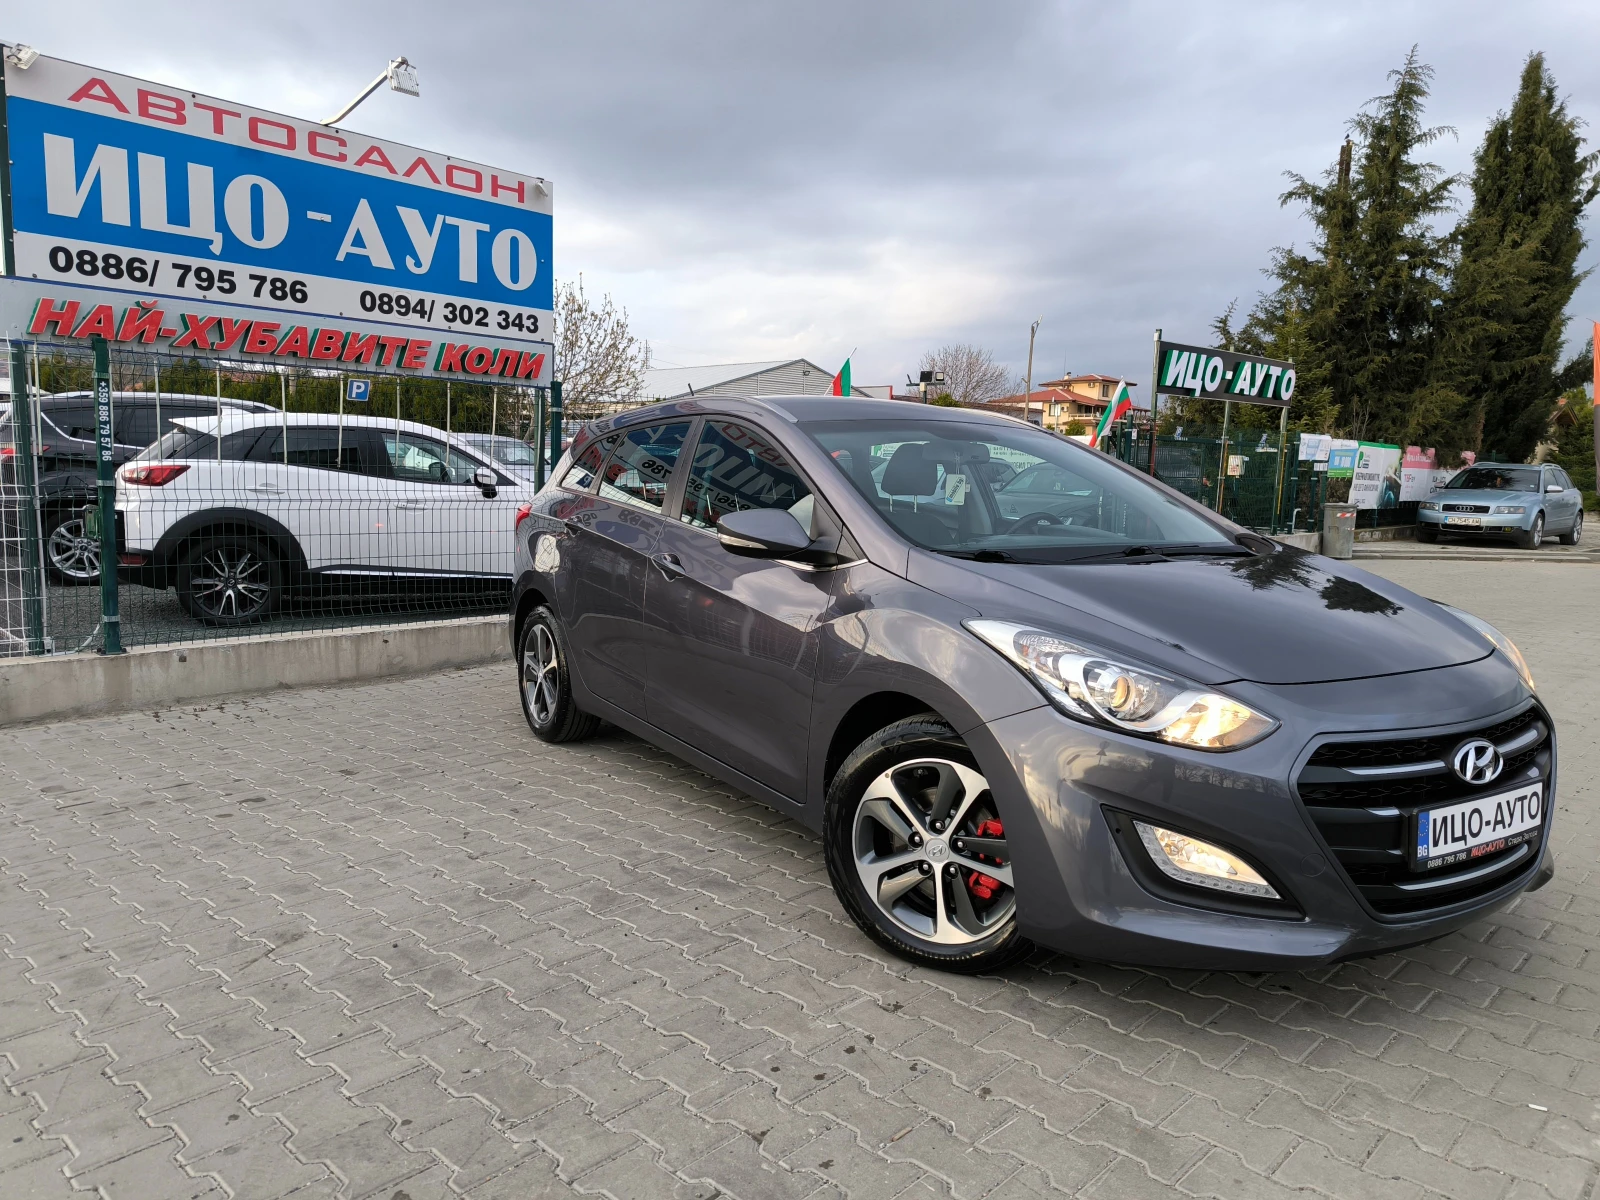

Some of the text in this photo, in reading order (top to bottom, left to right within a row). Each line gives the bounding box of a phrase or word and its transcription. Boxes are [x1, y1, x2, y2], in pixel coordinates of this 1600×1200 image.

[68, 77, 525, 204] АВТОСАЛОН
[48, 246, 309, 304] 0886/ 795 786
[28, 297, 546, 380] НАЙ-ХУБАВИТЕ КОЛИ
[359, 290, 539, 334] 0894/ 302 343
[352, 382, 365, 397] P
[1162, 350, 1296, 400] ИЦО-АУТО
[98, 381, 112, 461] +359 886 79 57 86
[1432, 791, 1541, 847] ИЦО-АУТО
[1417, 844, 1428, 858] BG
[1443, 855, 1455, 864] 795
